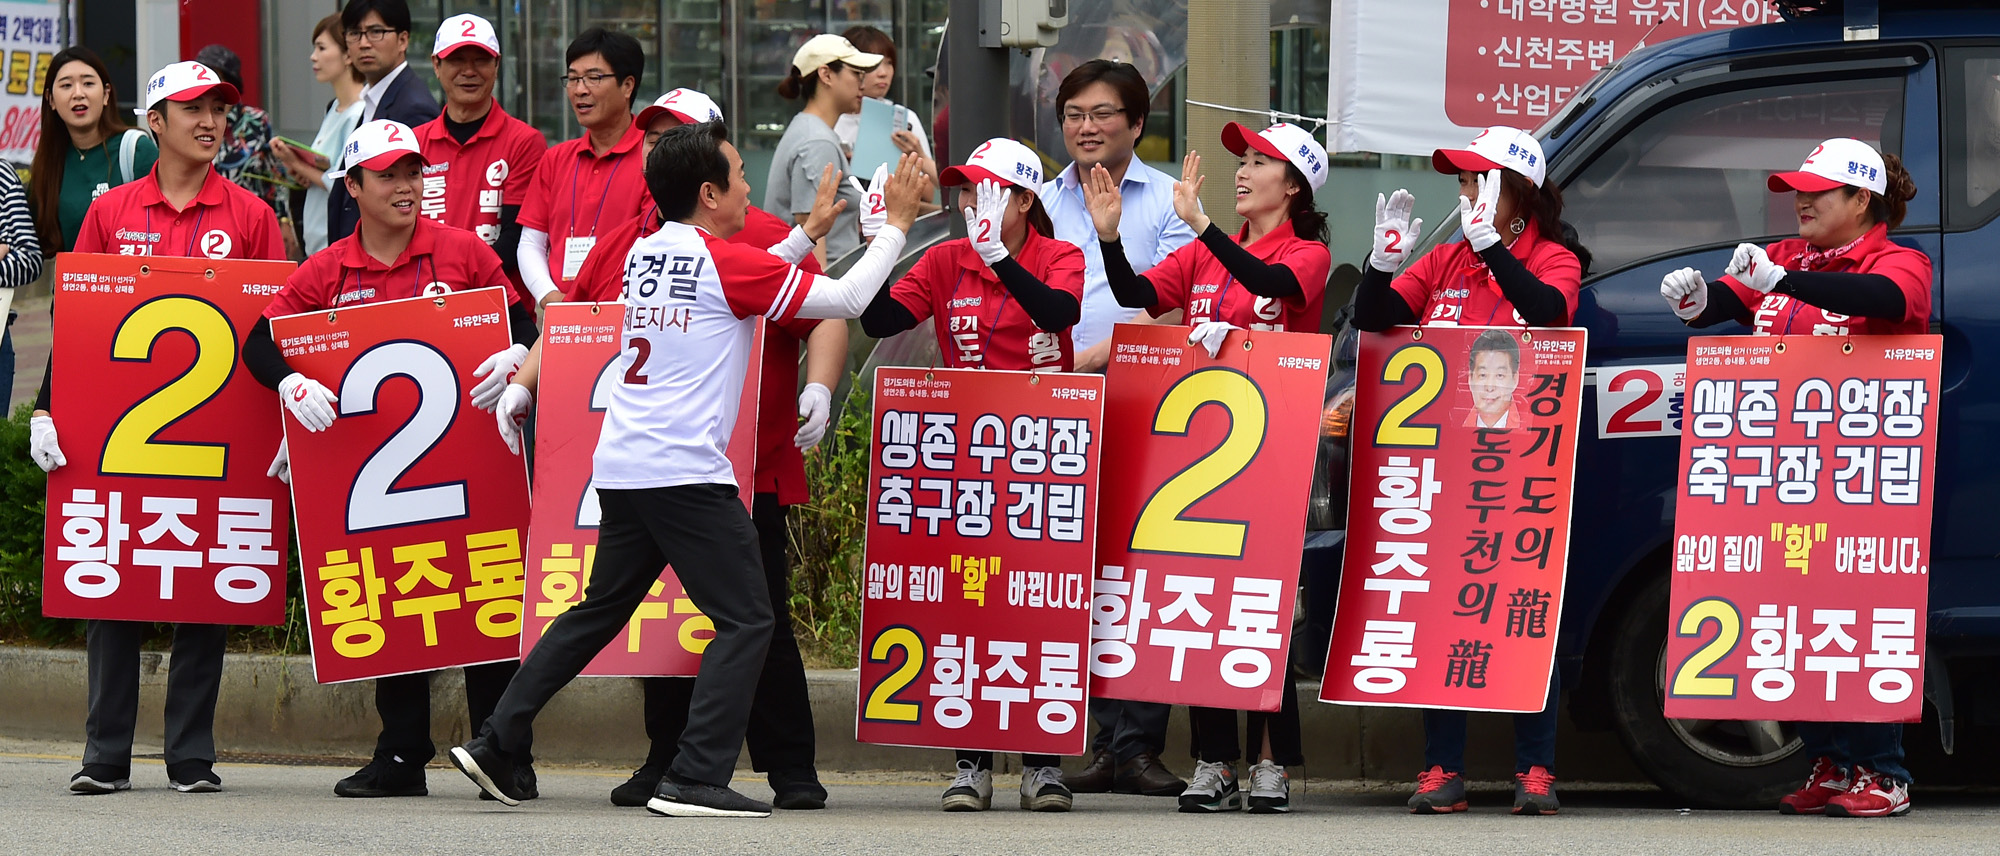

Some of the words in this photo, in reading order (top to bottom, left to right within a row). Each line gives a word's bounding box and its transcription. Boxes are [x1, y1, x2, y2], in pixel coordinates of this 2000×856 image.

[1698, 0, 1785, 29] (소아
[461, 19, 476, 37] 2
[1493, 36, 1615, 71] 신천주변
[192, 64, 212, 81] 2
[663, 89, 682, 105] 2
[384, 123, 403, 142] 2
[972, 141, 992, 159] 2
[1298, 144, 1321, 174] 황주룡
[1508, 143, 1537, 168] 황주룡
[1804, 144, 1824, 164] 2
[491, 163, 503, 182] 2
[1015, 162, 1039, 184] 황주룡
[1847, 161, 1878, 181] 황주룡
[869, 193, 886, 215] 2
[1471, 203, 1487, 225] 2
[976, 218, 991, 243] 2
[1384, 229, 1402, 253] 2
[207, 233, 224, 255] 2
[62, 272, 98, 282] 경기도의원
[453, 312, 500, 328] 자유한국당
[549, 325, 581, 334] 경기도의원
[950, 315, 978, 332] 경기
[281, 335, 314, 348] 경기도의원
[1117, 344, 1148, 354] 경기도의원
[1532, 340, 1576, 352] 자유한국당
[1696, 346, 1732, 356] 경기도의원
[1884, 348, 1934, 360] 자유한국당
[623, 337, 651, 385] 2
[1278, 357, 1322, 370] 자유한국당
[98, 293, 239, 481] 2
[883, 377, 916, 387] 경기도의원
[1052, 388, 1097, 401] 자유한국당
[1372, 342, 1448, 450] 2
[1606, 369, 1664, 434] 2
[1691, 378, 1779, 439] 생존
[1791, 378, 1930, 439] 수영장
[337, 339, 470, 535] 2
[880, 410, 958, 471] 생존
[969, 413, 1092, 477] 수영장
[1127, 365, 1269, 561] 2
[1511, 372, 1567, 570] 경기도의
[1687, 443, 1821, 505] 축구장
[1833, 444, 1923, 505] 건립
[877, 474, 995, 538] 축구장
[1004, 482, 1086, 543] 건립
[57, 489, 279, 604] 황주룡
[1676, 535, 1717, 573] 삶의
[1723, 535, 1763, 573] 질이
[1836, 536, 1927, 575] 바뀝니다.
[868, 562, 903, 600] 삶의
[909, 565, 944, 603] 질이
[1007, 570, 1089, 610] 바뀝니다.
[1350, 456, 1442, 694] 황주룡
[317, 528, 525, 658] 황주룡
[1505, 587, 1551, 639] 龍
[1090, 564, 1284, 689] 황주룡
[1668, 595, 1744, 699] 2
[1746, 604, 1919, 703] 황주룡
[1444, 639, 1493, 689] 龍
[861, 624, 927, 724] 2
[929, 634, 1083, 735] 황주룡
